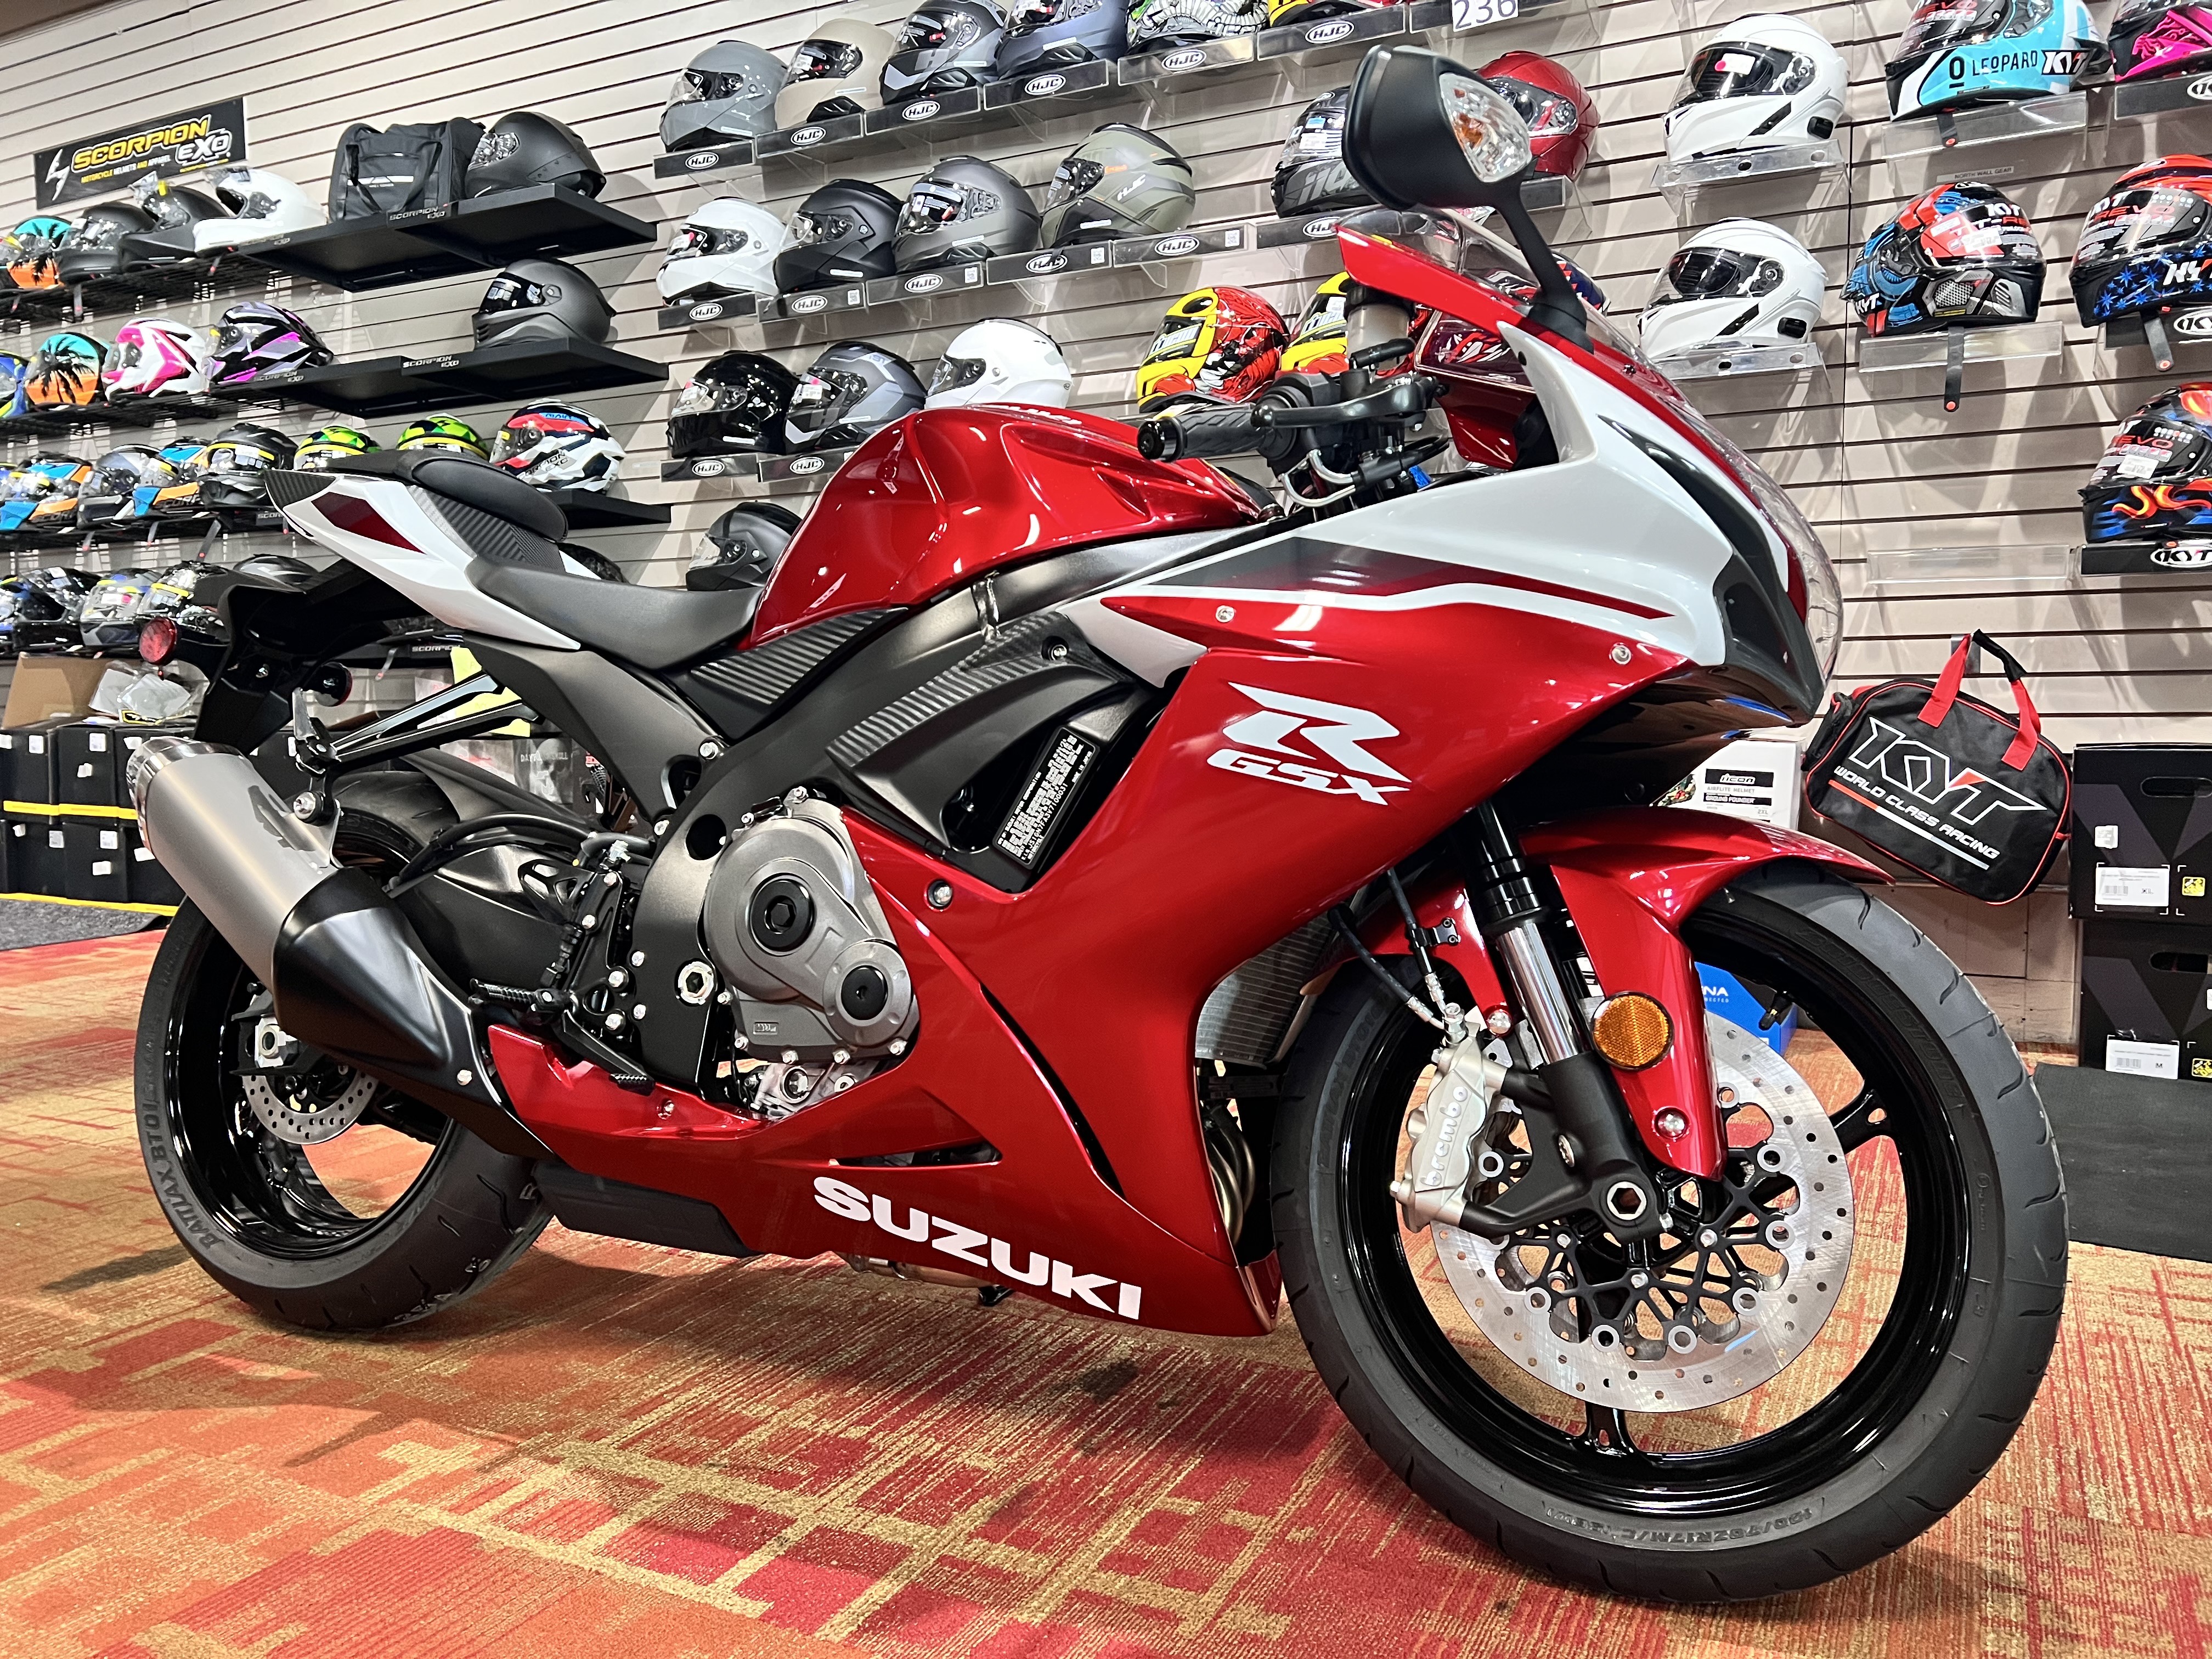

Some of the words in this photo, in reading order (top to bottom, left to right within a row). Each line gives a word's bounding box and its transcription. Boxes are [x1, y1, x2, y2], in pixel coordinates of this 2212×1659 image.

[1454, 0, 1516, 29] 236
[1312, 25, 1347, 39] HJC
[1168, 54, 1199, 66] HJC
[1972, 50, 2038, 76] LEOPARD
[2044, 52, 2085, 75] KYT
[1031, 78, 1059, 91] HJC
[908, 104, 934, 116] HJC
[796, 130, 821, 142] HJC
[74, 119, 208, 170] SCORPION
[691, 155, 714, 165] HJC
[389, 206, 438, 221] SCORPION
[1161, 240, 1193, 251] HJC
[910, 278, 937, 289] HJC
[797, 298, 822, 309] HJC
[695, 306, 718, 316] HJC
[403, 355, 453, 368] SCORPION
[697, 464, 720, 472] HJC
[795, 460, 819, 470] HJC
[1222, 681, 1412, 783] R
[1207, 748, 1410, 805] GSX
[1848, 716, 2047, 826] KYT
[1834, 765, 1886, 800] WORLD
[1886, 795, 1940, 828] CLASS
[1939, 824, 2000, 860] RACING
[1420, 1086, 1468, 1187] brembo
[814, 1177, 1142, 1320] SUZUKI
